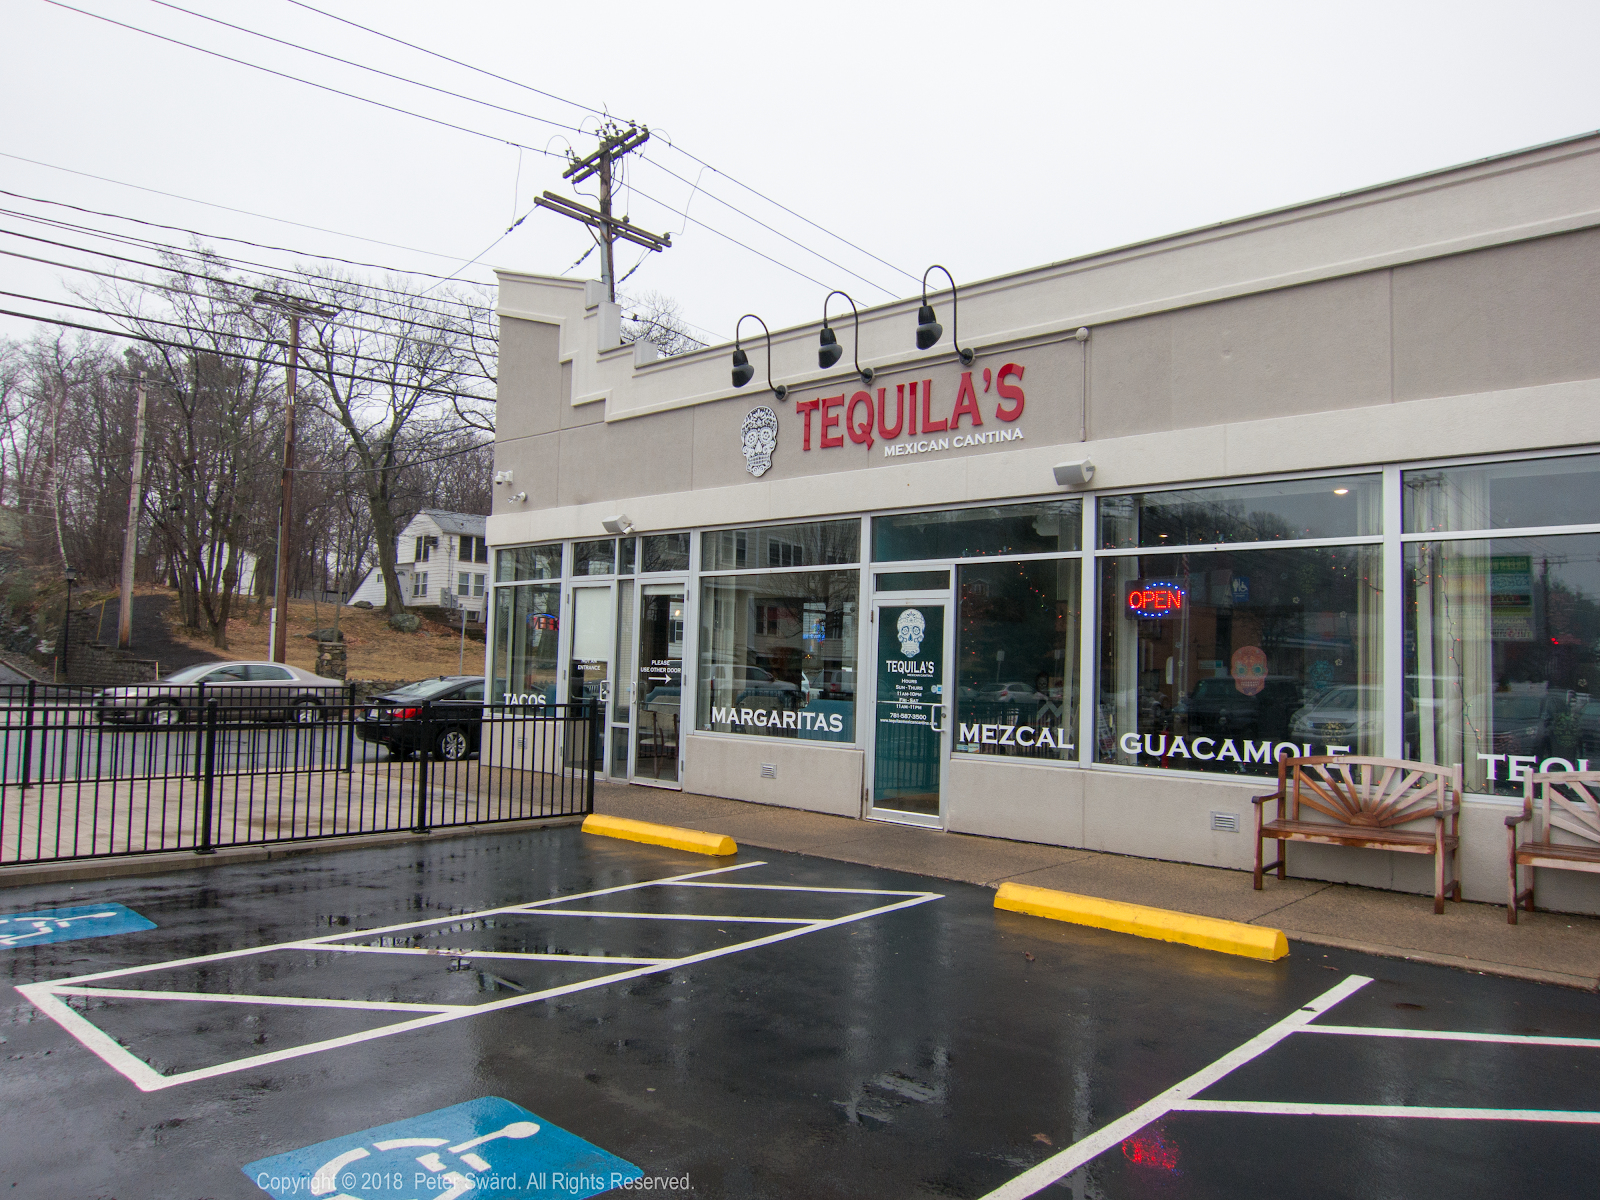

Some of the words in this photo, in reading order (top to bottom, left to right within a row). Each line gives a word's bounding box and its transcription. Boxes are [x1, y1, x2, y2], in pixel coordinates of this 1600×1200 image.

[796, 363, 1025, 450] TEQUILA'S
[884, 438, 949, 458] MEXICAN
[953, 428, 1024, 448] CANTINA
[1129, 590, 1181, 609] OPEN
[886, 660, 935, 674] TEQUILA'S
[503, 693, 547, 709] TACOS
[711, 706, 843, 733] MARGARITAS
[959, 722, 1075, 750] MEZCAL
[1119, 732, 1350, 769] GUACAMOLE
